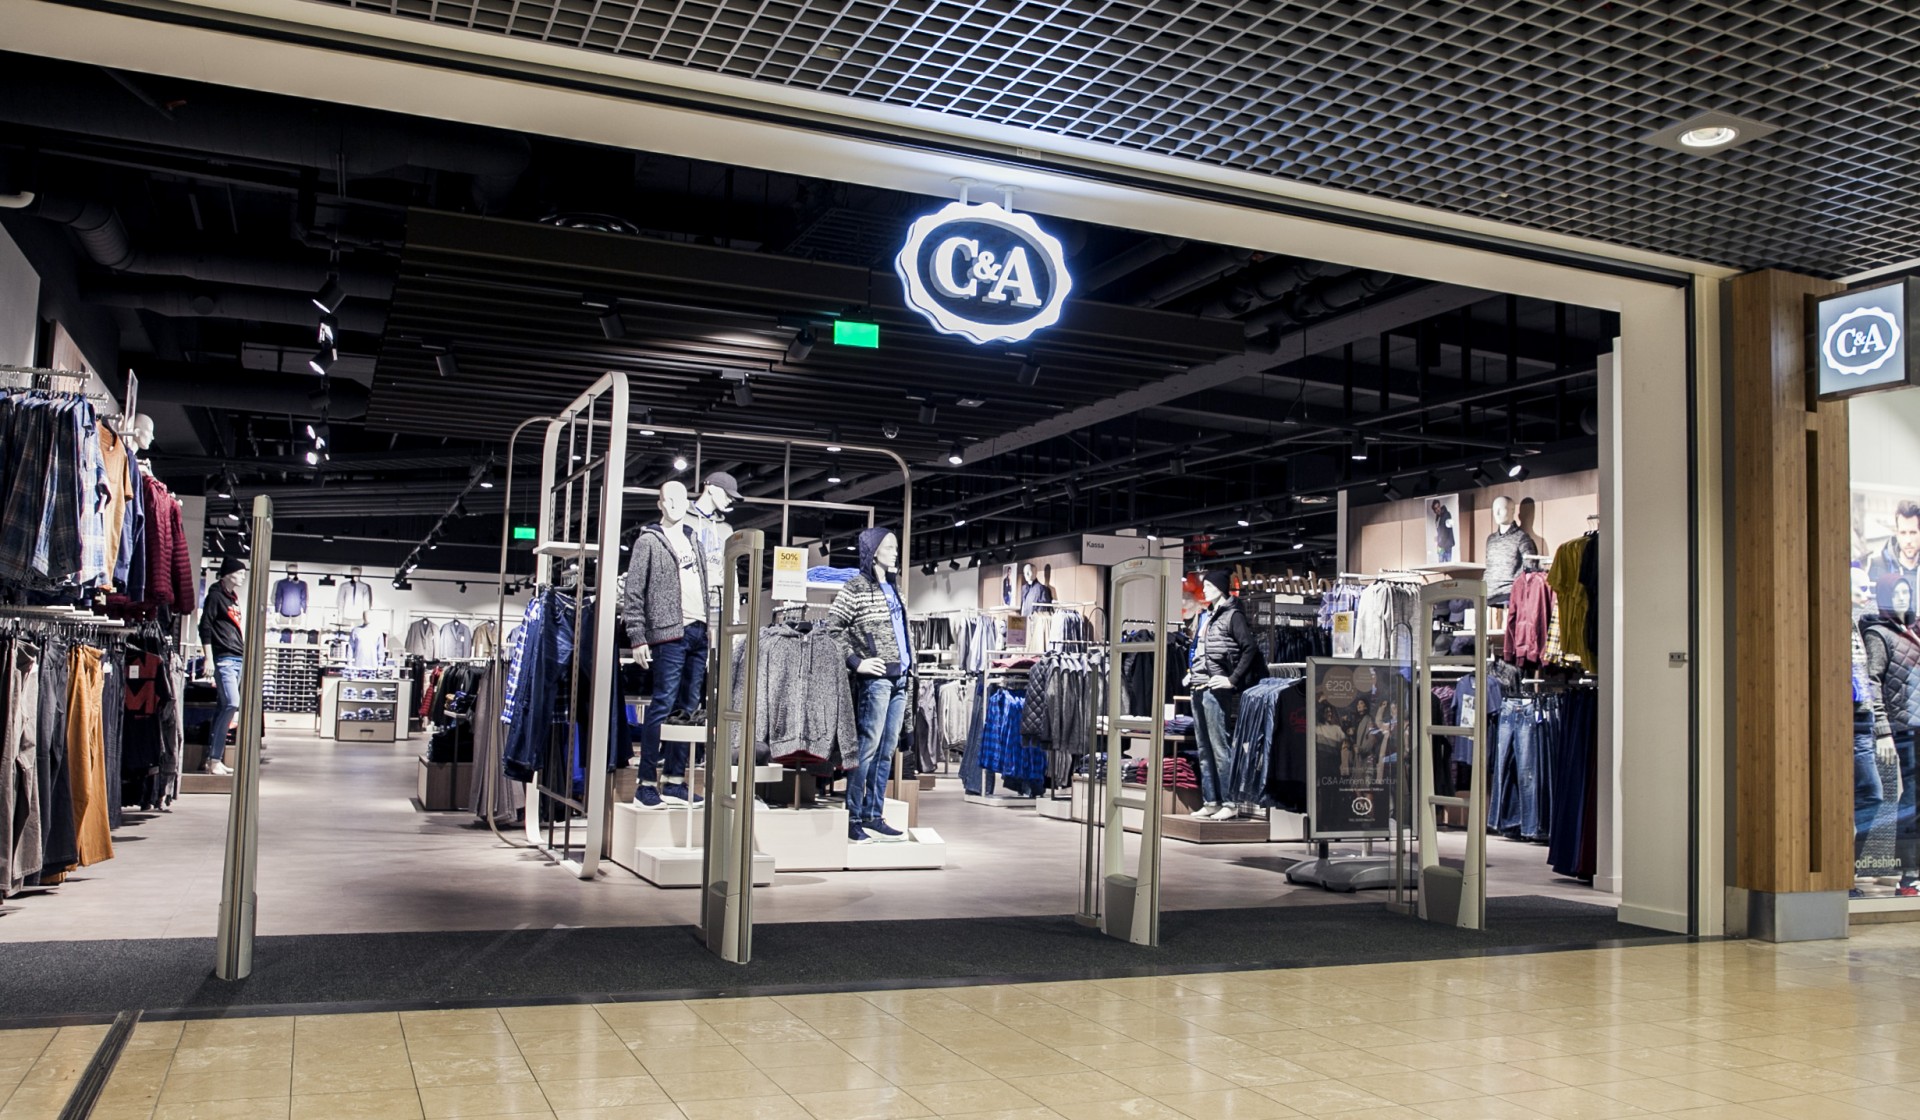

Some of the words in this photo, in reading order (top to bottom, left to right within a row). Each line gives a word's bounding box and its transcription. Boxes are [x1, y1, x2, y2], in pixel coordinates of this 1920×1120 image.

[931, 236, 1042, 307] C&A
[1836, 323, 1887, 358] C&A
[1086, 541, 1105, 549] Kassa
[780, 552, 799, 561] 50%
[1321, 776, 1337, 785] C&A
[1339, 776, 1365, 785] Arnhem
[1854, 855, 1902, 869] odFashion
